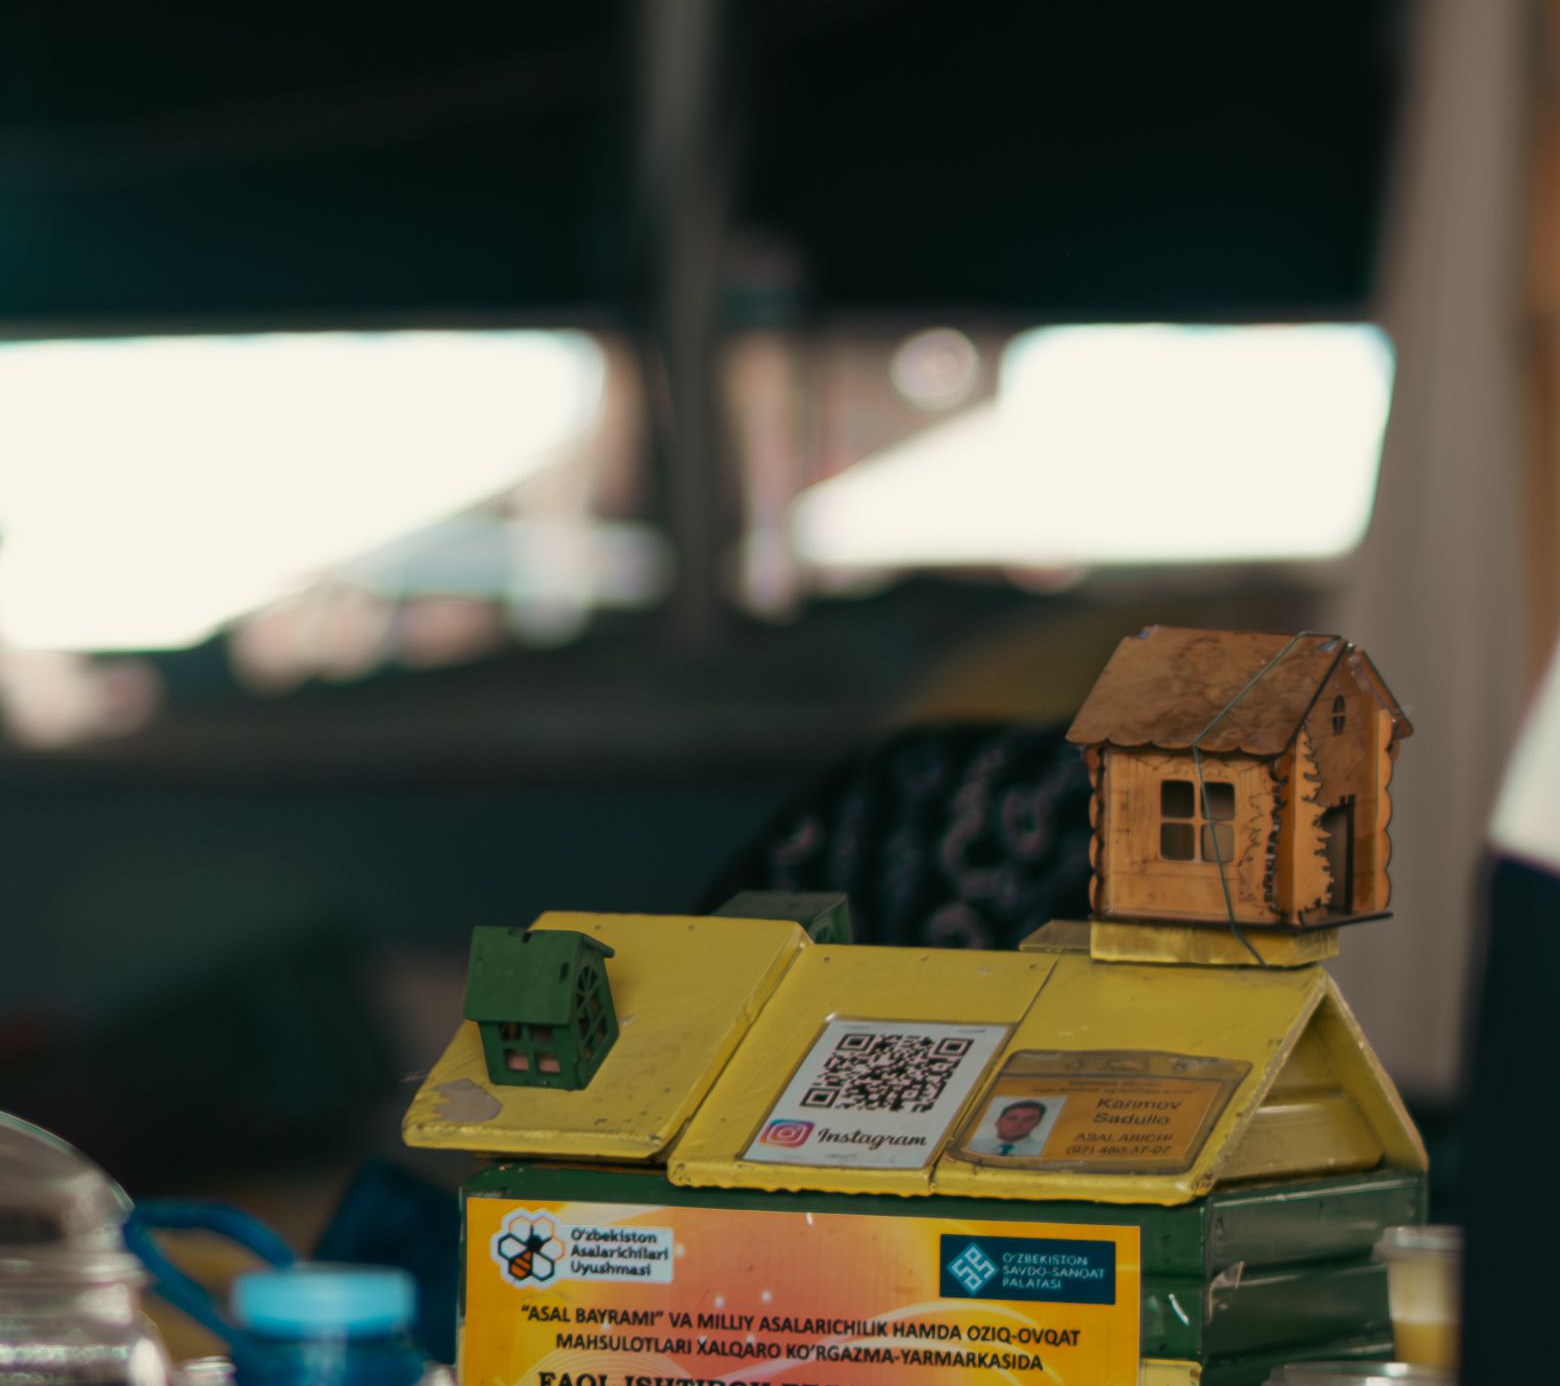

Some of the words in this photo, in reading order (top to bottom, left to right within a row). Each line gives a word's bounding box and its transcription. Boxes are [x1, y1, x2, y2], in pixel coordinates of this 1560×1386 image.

[1096, 1097, 1182, 1110] Karimov
[817, 1127, 927, 1151] Instagram
[571, 1228, 658, 1245] O'zbekiston
[570, 1245, 670, 1262] Asalarichilari
[1002, 1252, 1088, 1266] O'ZBEKISTON
[571, 1262, 652, 1278] Uyushmasi
[1002, 1265, 1105, 1280] SAVDO-SANOAT
[1002, 1277, 1062, 1290] PALATASI
[521, 1304, 571, 1323] "ASAL
[577, 1308, 664, 1327] BAYRAMI"
[669, 1312, 694, 1329] VA
[697, 1314, 756, 1331] MILLIY
[758, 1316, 888, 1337] ASALARICHILIK
[893, 1322, 962, 1341] HAMDA
[967, 1325, 1081, 1347] OZIQ-OVQAT
[556, 1333, 692, 1355] MAHSULOTLARI
[697, 1340, 781, 1360] XALQARO
[786, 1344, 1043, 1371] KO'RGAZMA-YARMARKASIDA
